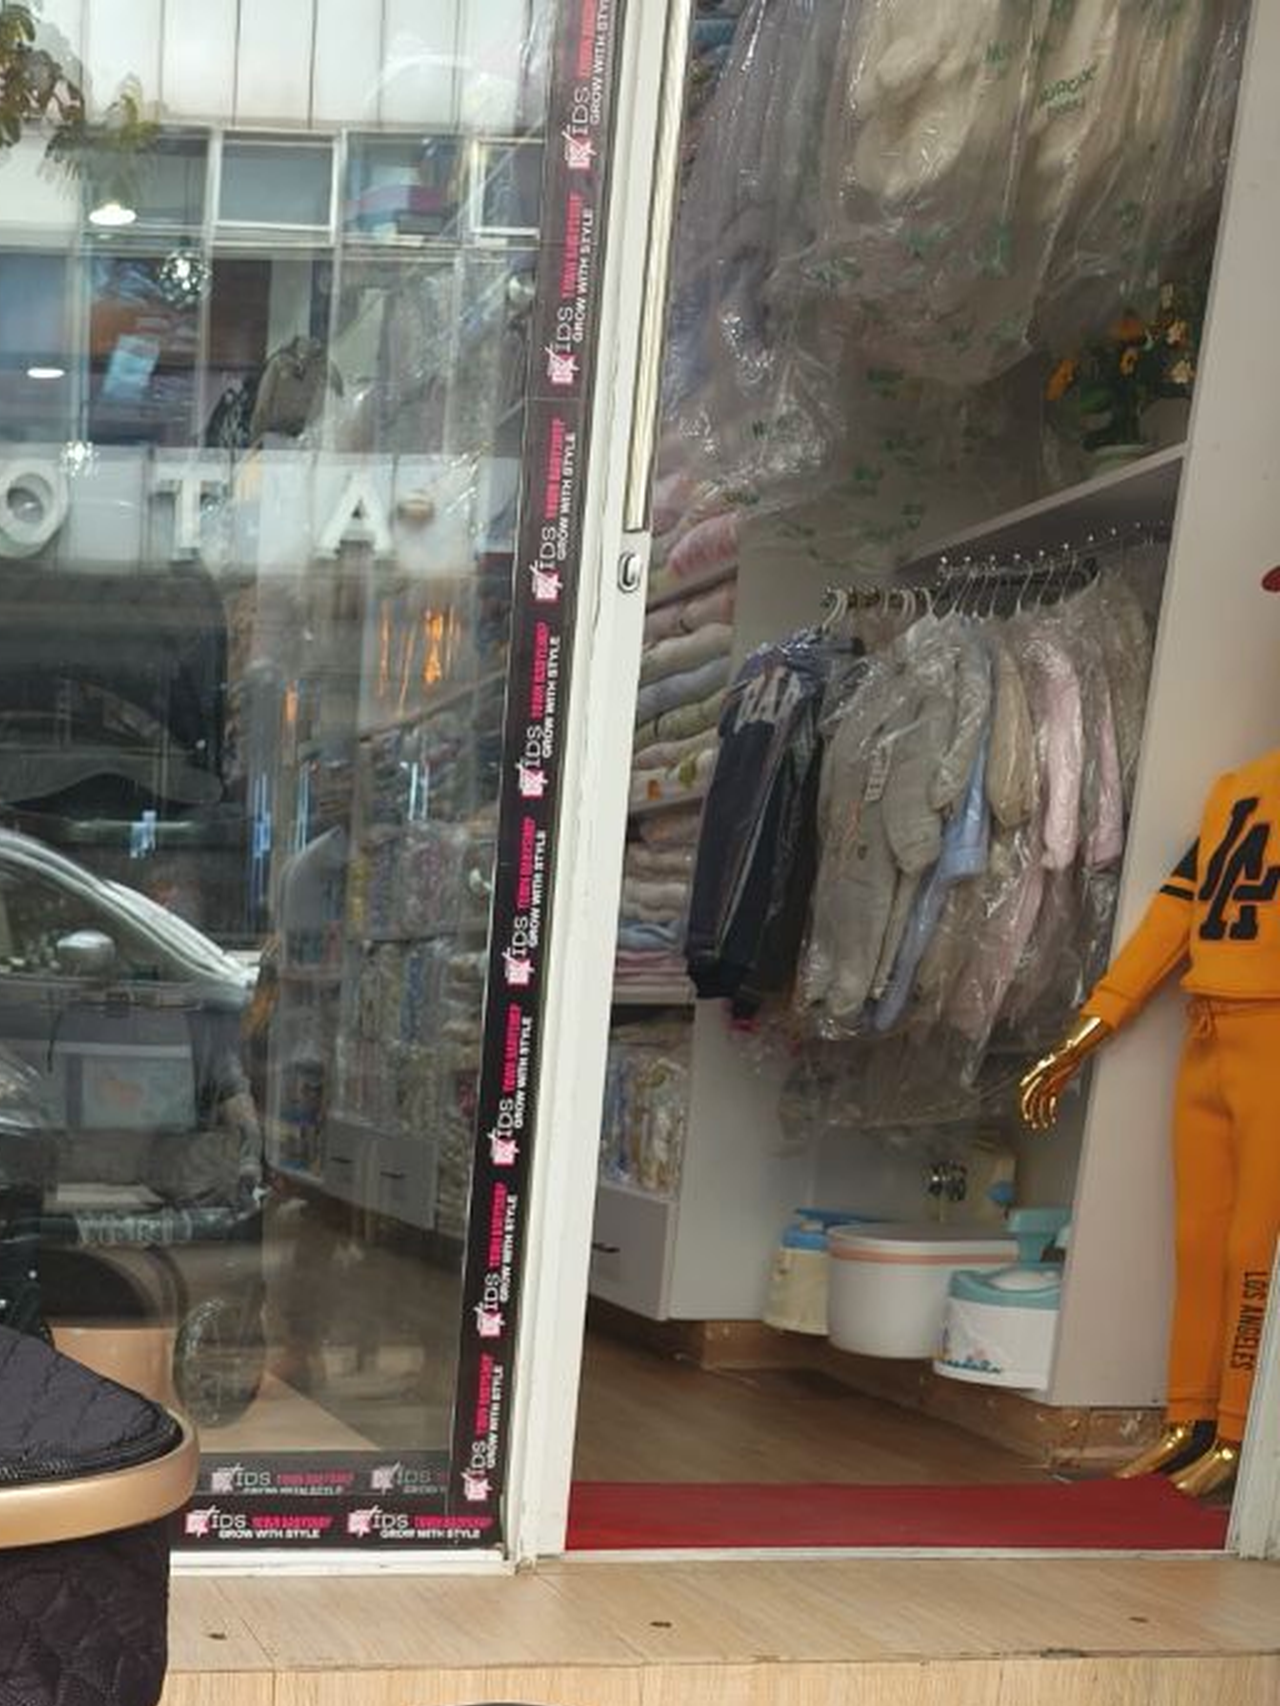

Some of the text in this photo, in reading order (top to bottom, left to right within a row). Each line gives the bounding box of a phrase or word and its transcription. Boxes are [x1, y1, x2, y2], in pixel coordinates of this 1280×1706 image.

[578, 207, 593, 254] STYLE
[572, 296, 587, 342] GROW
[532, 829, 547, 870] STYLE
[528, 907, 541, 948] GROW
[519, 1015, 532, 1055] STYLE
[513, 1088, 527, 1129] GROW
[1229, 1271, 1270, 1372] LOS ANGELES
